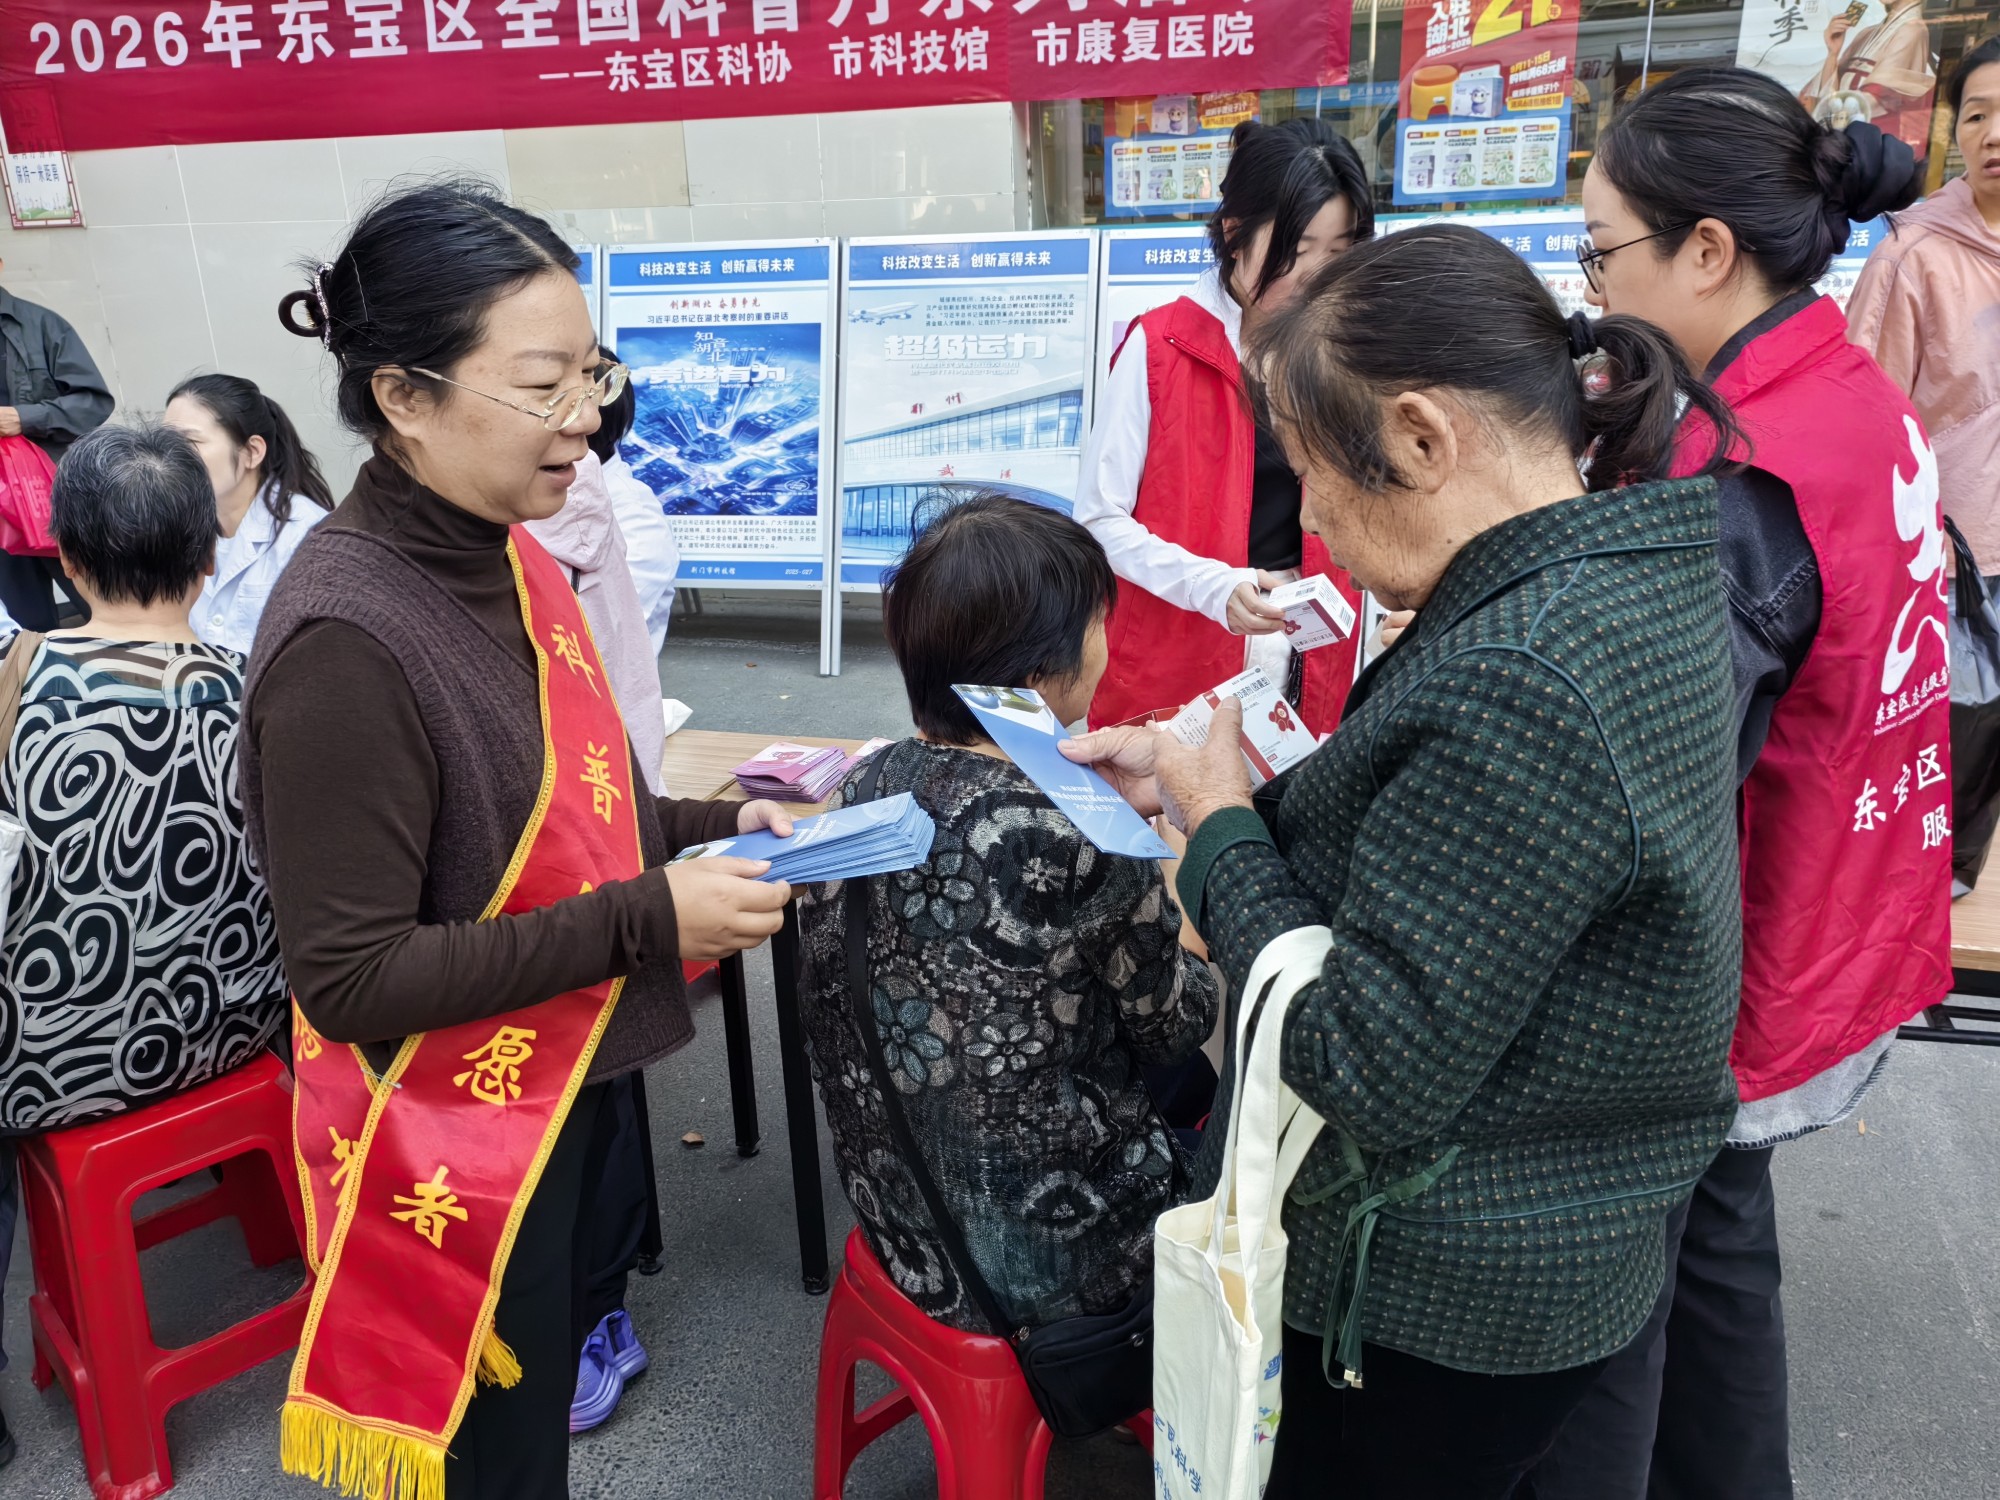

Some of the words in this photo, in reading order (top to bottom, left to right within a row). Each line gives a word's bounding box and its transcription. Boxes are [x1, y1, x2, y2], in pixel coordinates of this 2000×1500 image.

[1426, 16, 1470, 48] 湖北
[828, 26, 989, 79] 市科技馆
[1032, 11, 1255, 66] 市康复医院
[639, 261, 712, 277] 科技改变生活
[721, 258, 795, 274] 创新赢得未来
[881, 253, 960, 271] 科技改变生活
[971, 251, 1051, 268] 创新赢得未来
[647, 311, 789, 324] 习近平总书记在湖北考察时的重要讲话
[884, 332, 1047, 361] 超级运力
